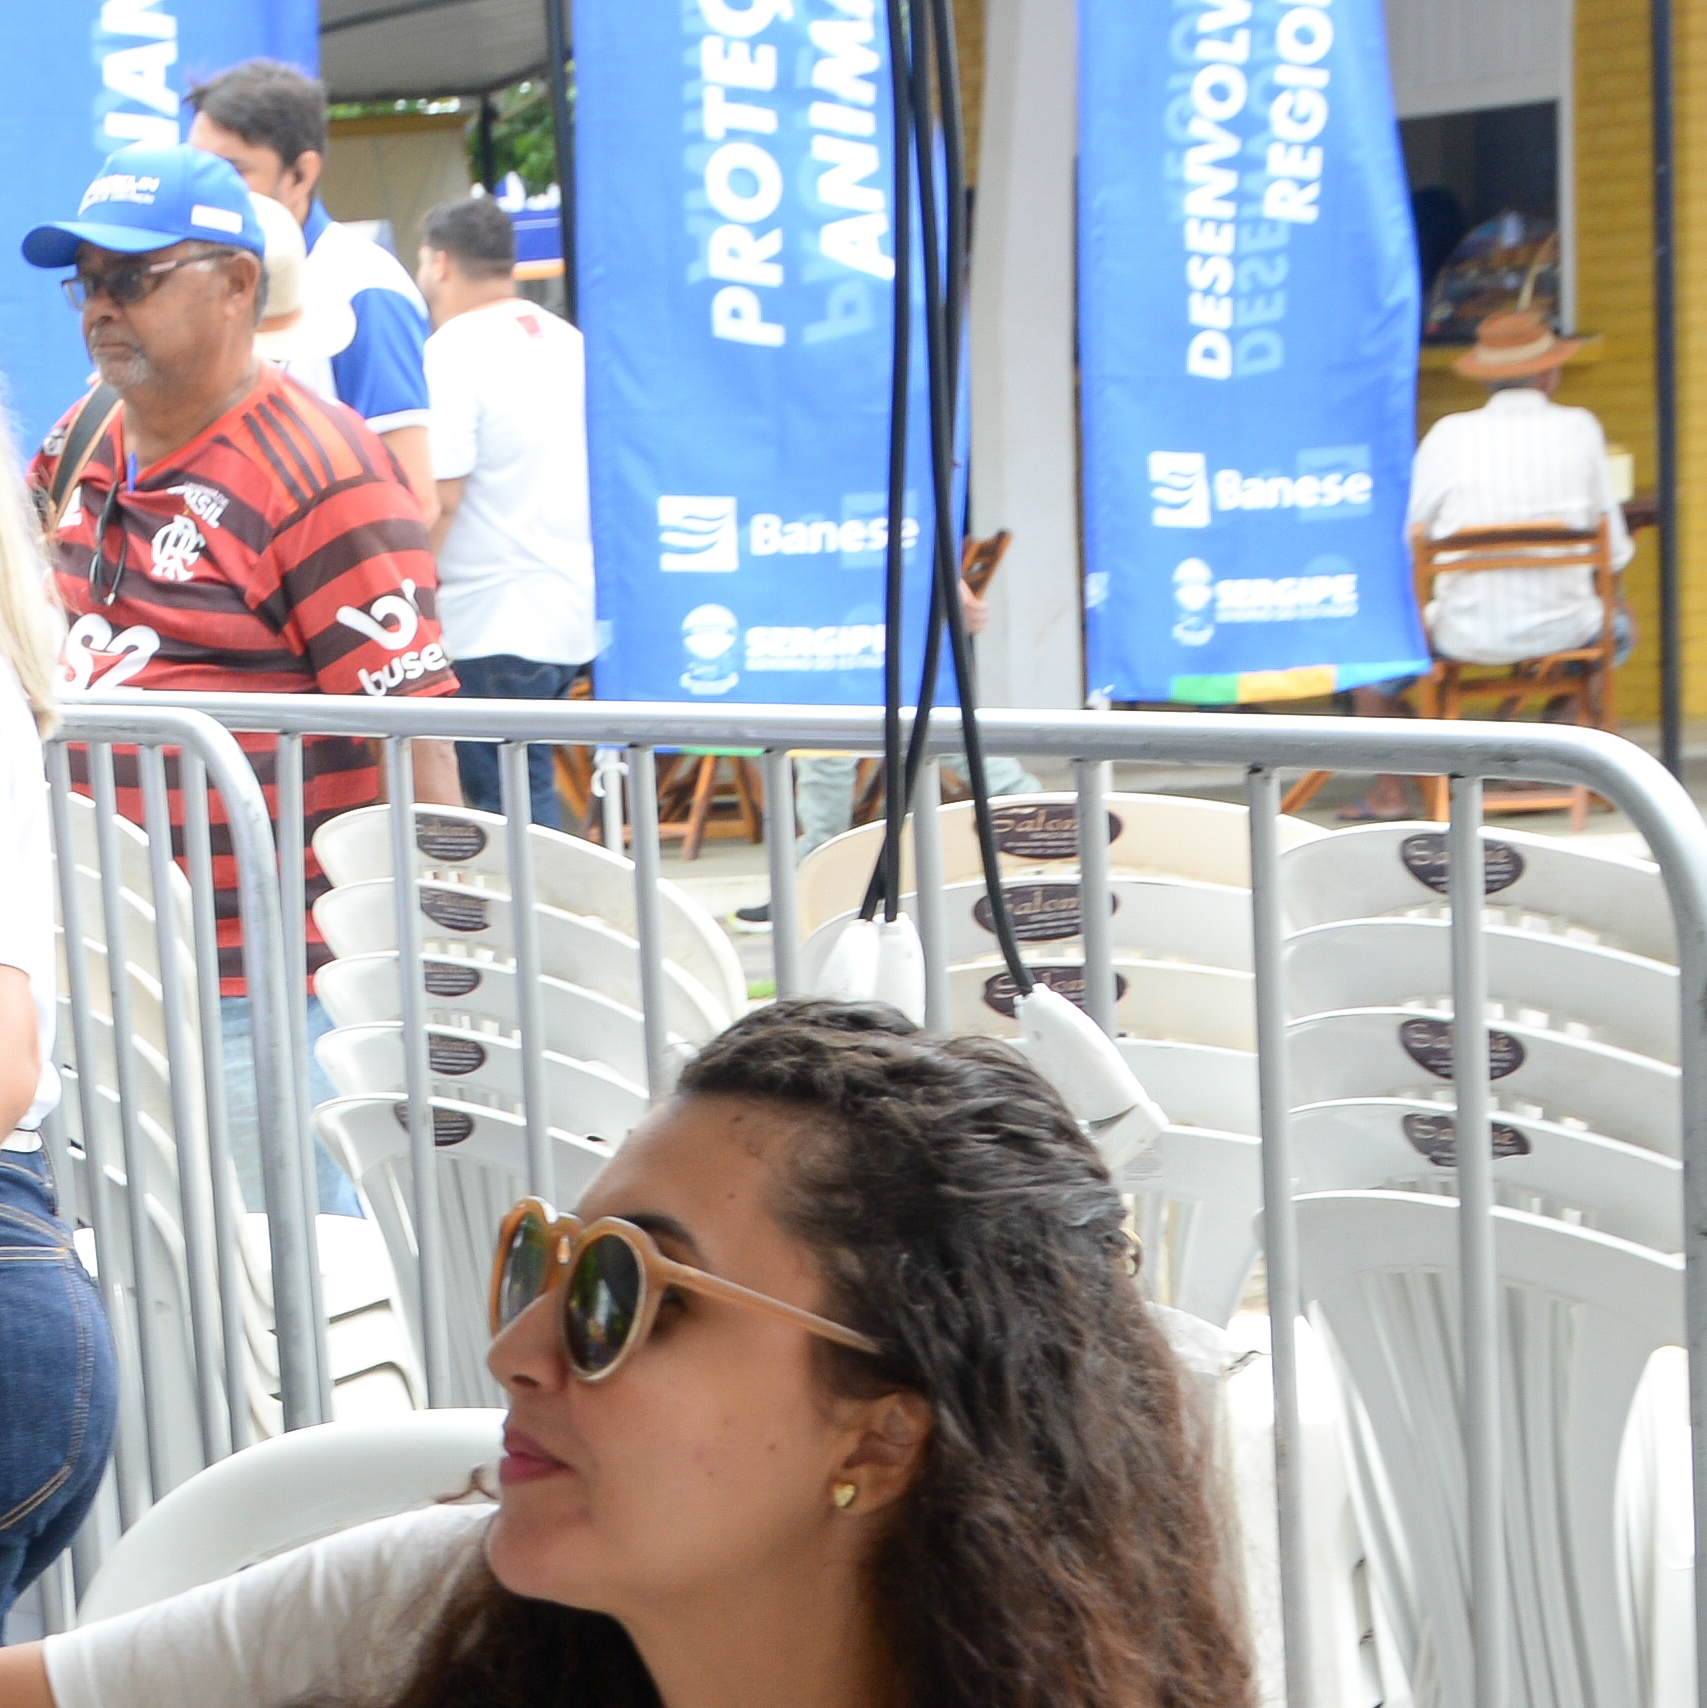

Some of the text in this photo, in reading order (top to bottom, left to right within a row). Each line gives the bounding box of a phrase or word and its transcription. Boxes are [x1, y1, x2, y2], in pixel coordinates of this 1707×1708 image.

[807, 0, 895, 281] ANIM
[1263, 0, 1334, 224] REGIO
[1214, 468, 1373, 512] Banese
[357, 643, 448, 697] buse
